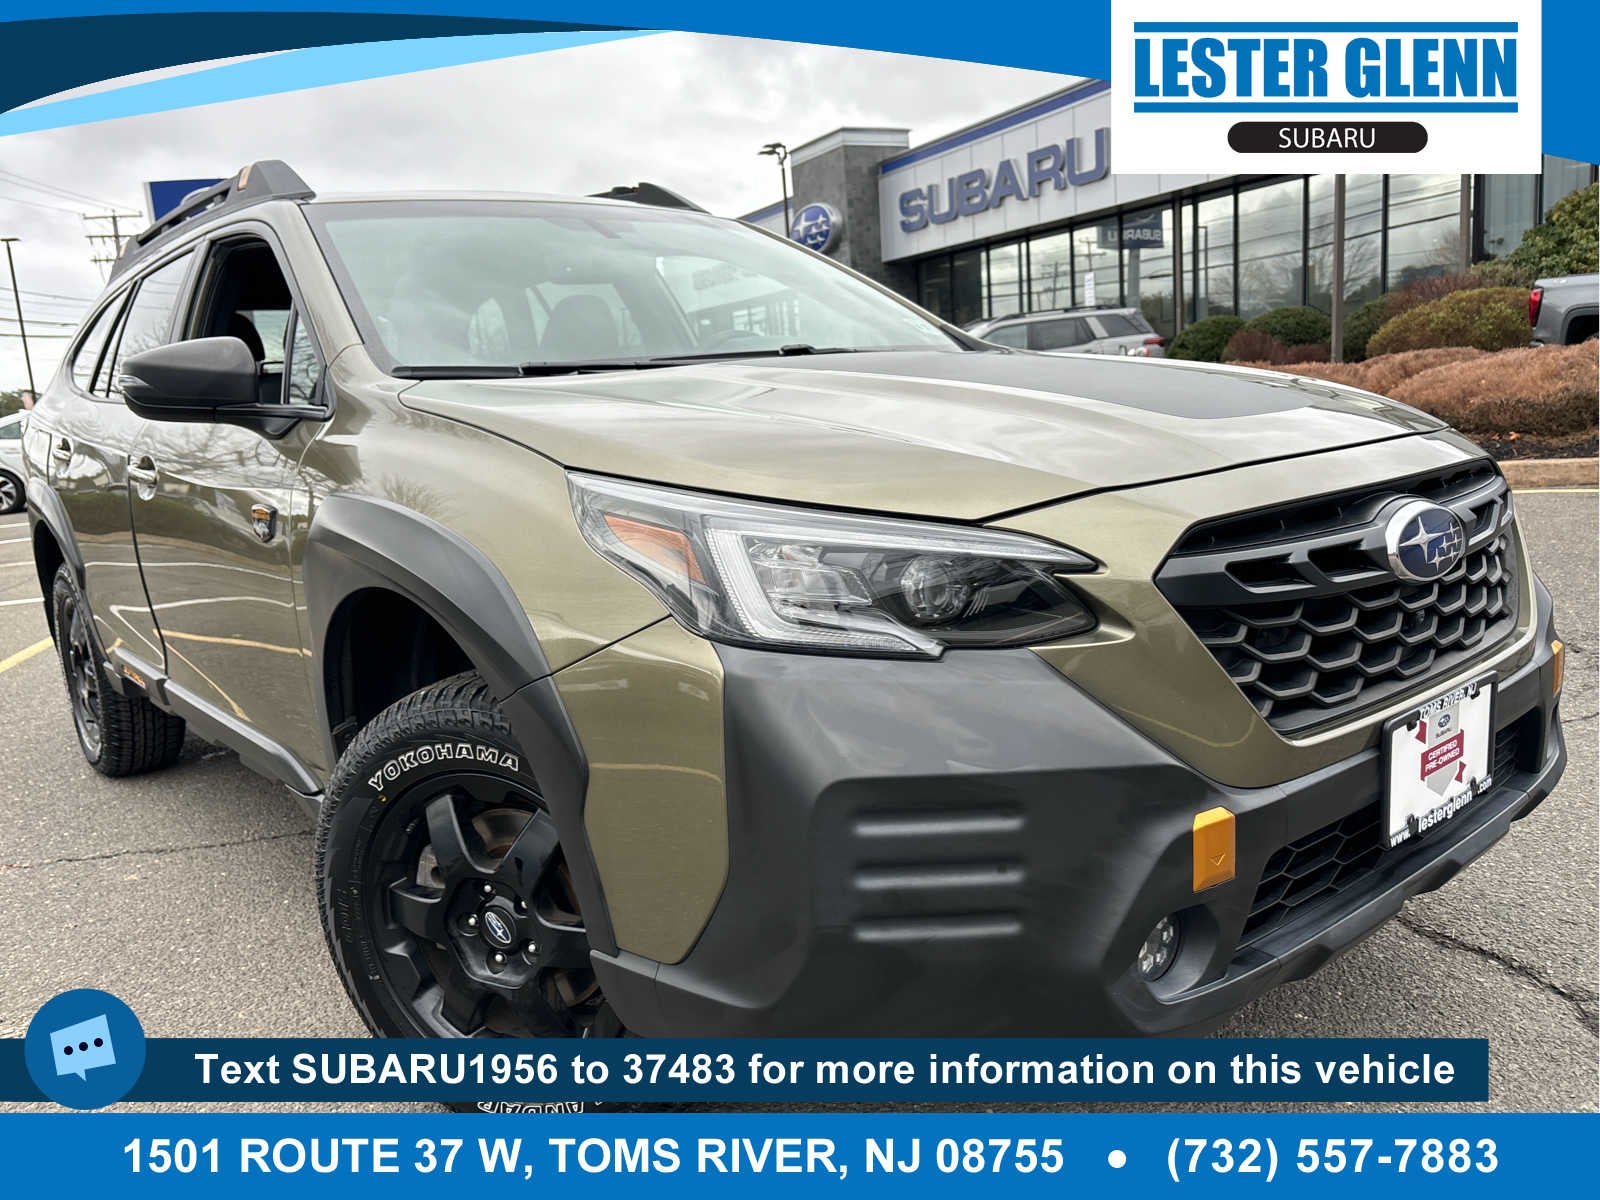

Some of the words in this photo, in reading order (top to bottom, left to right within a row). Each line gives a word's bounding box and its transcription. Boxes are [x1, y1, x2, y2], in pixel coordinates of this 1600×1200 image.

[899, 127, 1111, 234] SUBARU
[368, 743, 519, 791] YOKOHAMA
[1425, 748, 1460, 772] PRE-OWNED
[1428, 740, 1458, 760] CERTIFIED
[1391, 828, 1411, 848] www.
[1418, 790, 1472, 833] lesterglenn
